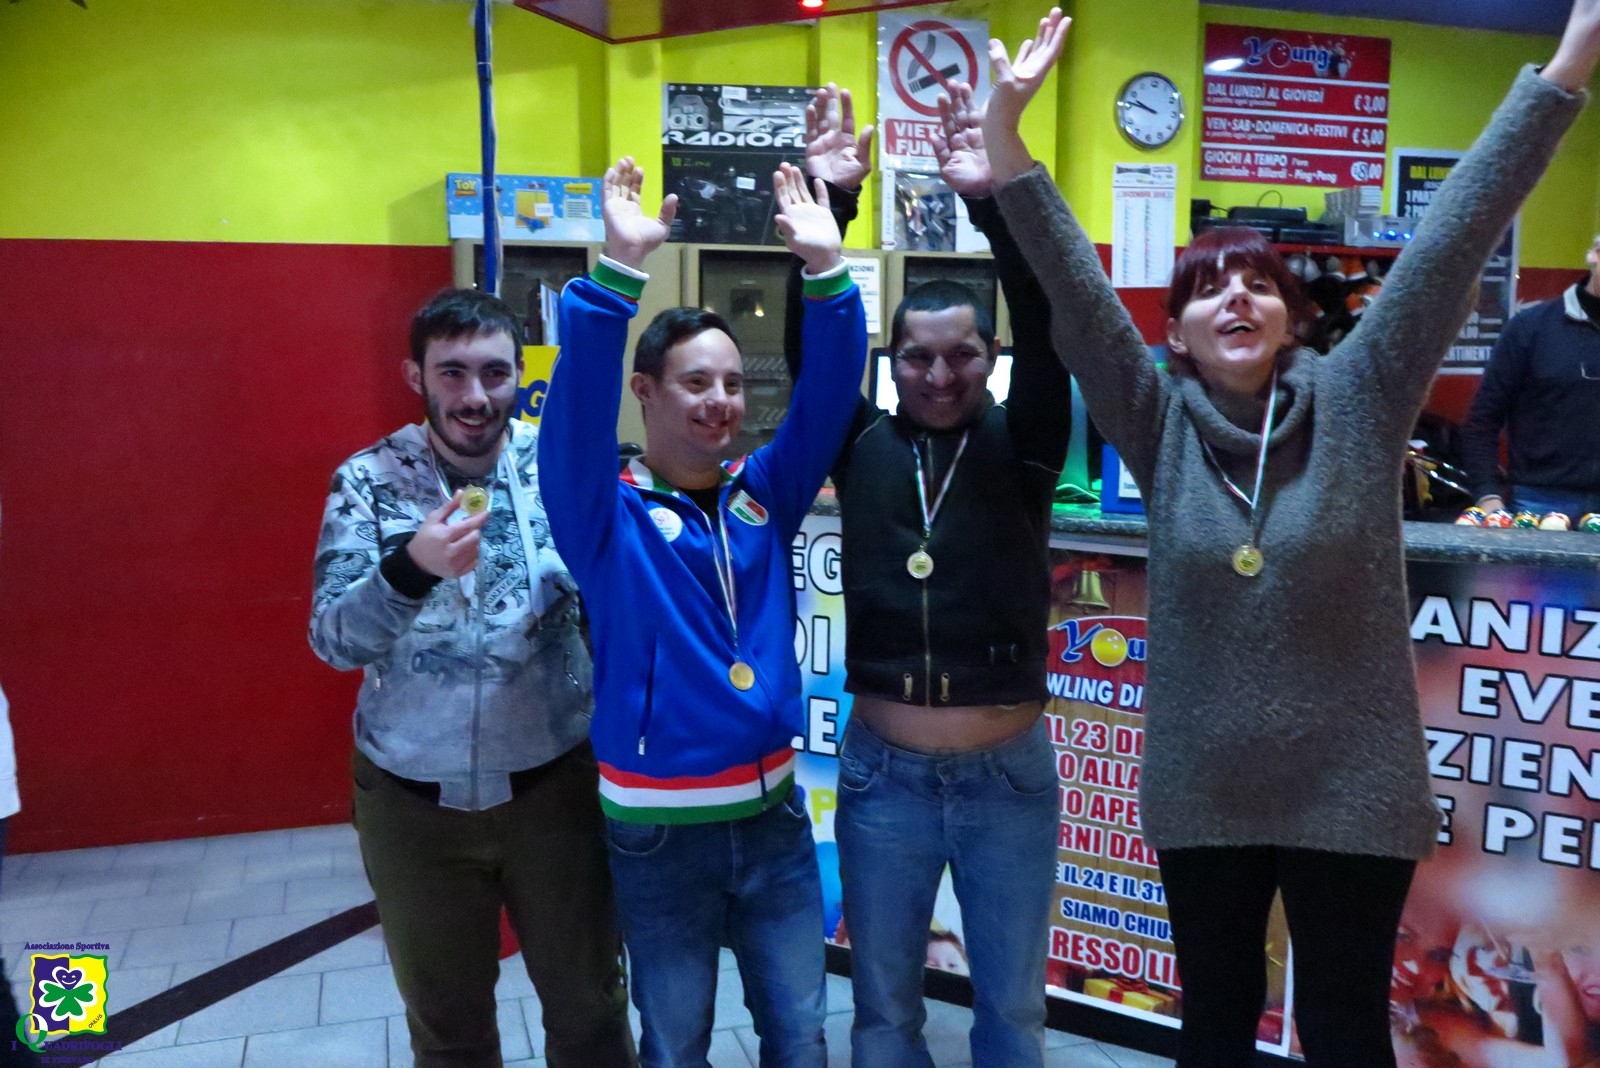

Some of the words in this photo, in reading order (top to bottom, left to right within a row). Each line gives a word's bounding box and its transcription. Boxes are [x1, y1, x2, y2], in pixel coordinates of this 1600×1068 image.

[1243, 36, 1329, 70] Young
[1207, 82, 1227, 96] DAL
[1229, 82, 1266, 99] LUNEDÌ
[1267, 87, 1280, 100] AL
[1282, 87, 1325, 103] GIOVEDÌ
[1354, 94, 1361, 110] €
[1363, 95, 1386, 113] 3,00
[662, 130, 807, 149] RADIOFL
[1352, 128, 1360, 144] €
[1362, 128, 1384, 147] 5,00
[1204, 150, 1242, 164] GIOCHI
[1243, 152, 1252, 165] A
[1254, 153, 1288, 167] TEMPO
[1461, 665, 1600, 730] EVE
[1072, 719, 1108, 752] 23
[1081, 757, 1141, 793] ALLA
[1089, 792, 1139, 828] APE
[1108, 831, 1159, 868] DAL
[1484, 804, 1600, 870] PE
[1064, 865, 1078, 882] IL
[1083, 868, 1104, 891] 24
[1109, 874, 1118, 894] E
[1122, 880, 1138, 900] IL
[1142, 882, 1163, 903] 31
[1063, 899, 1120, 928] SIAMO
[1052, 929, 1141, 977] RESSO
[1147, 952, 1181, 987] LI
